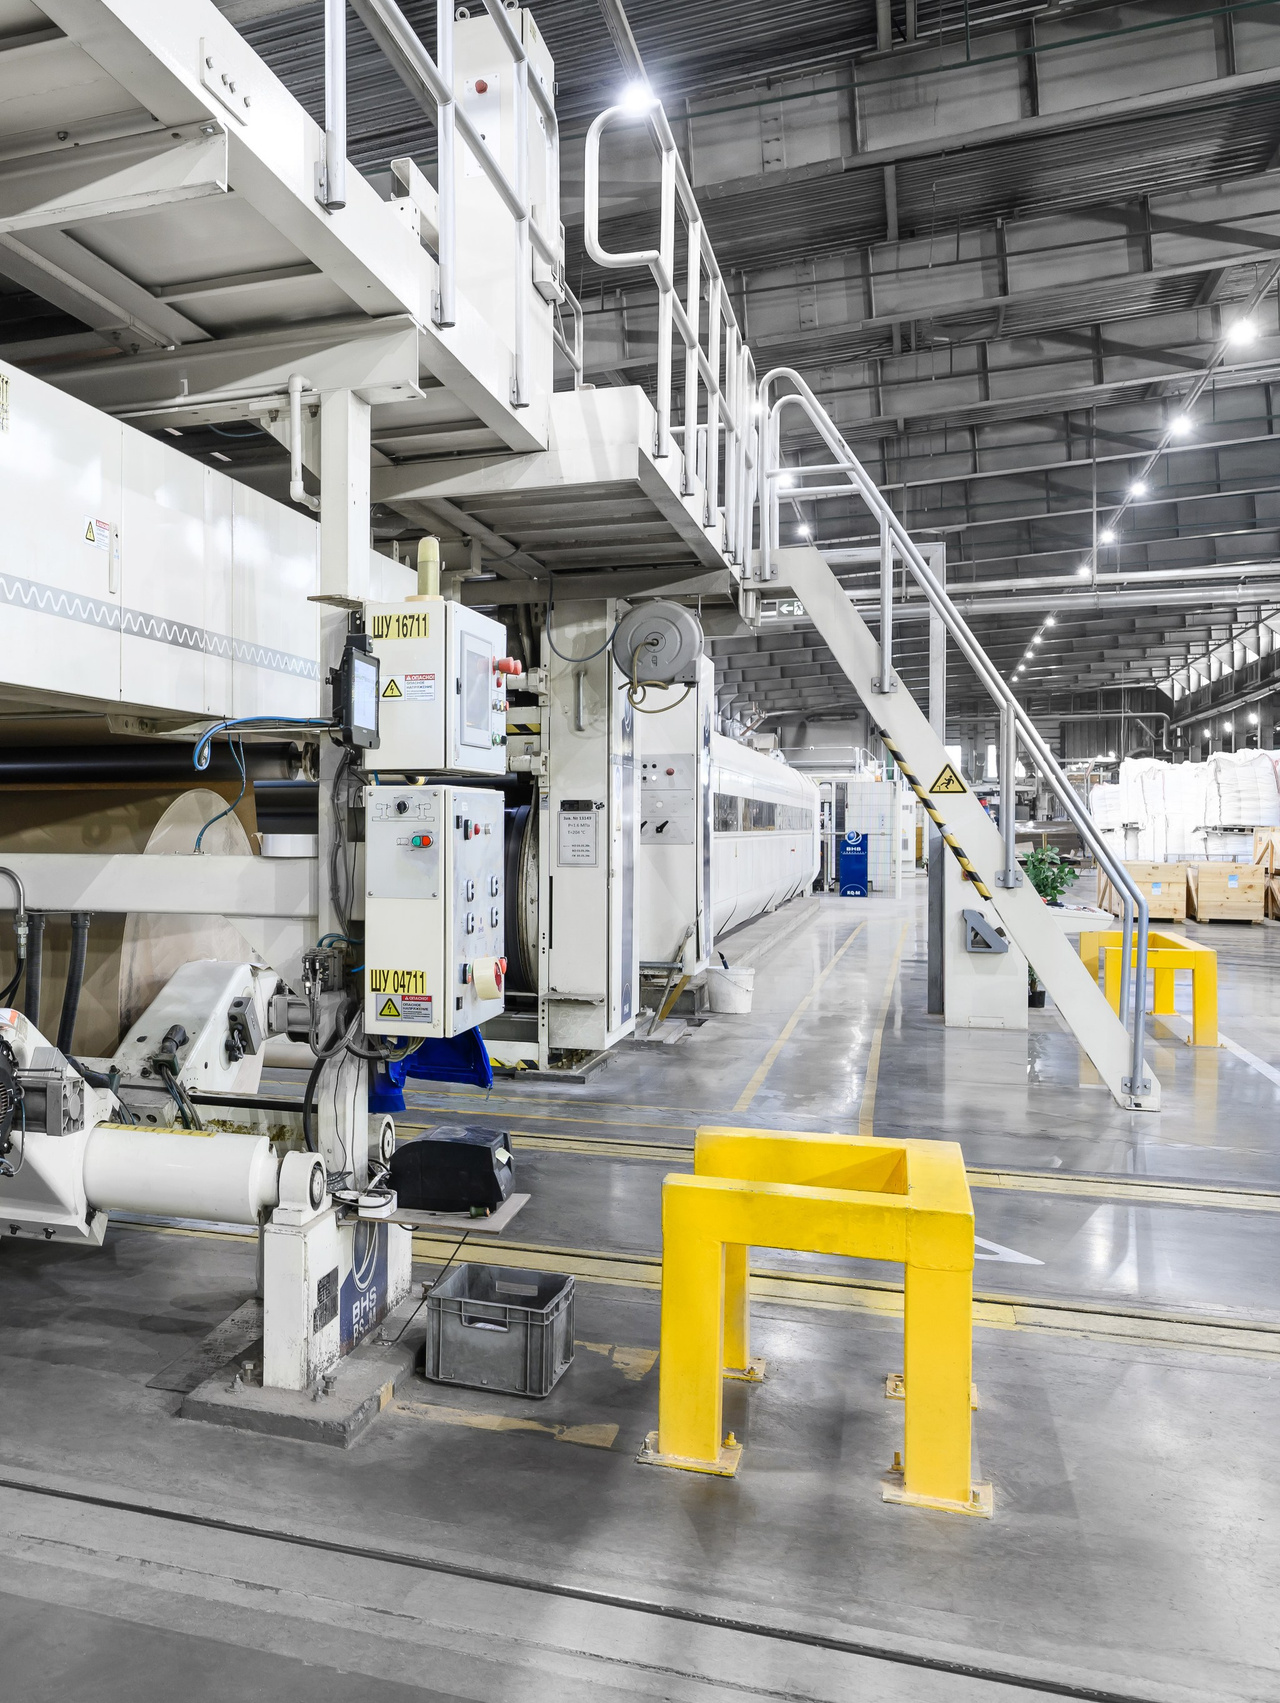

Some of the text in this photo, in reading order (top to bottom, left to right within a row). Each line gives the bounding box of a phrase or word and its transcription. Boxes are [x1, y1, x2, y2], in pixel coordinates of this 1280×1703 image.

[373, 614, 426, 638] ШУ 16711
[371, 969, 424, 993] ШУ 04711
[352, 1286, 377, 1325] BHS
